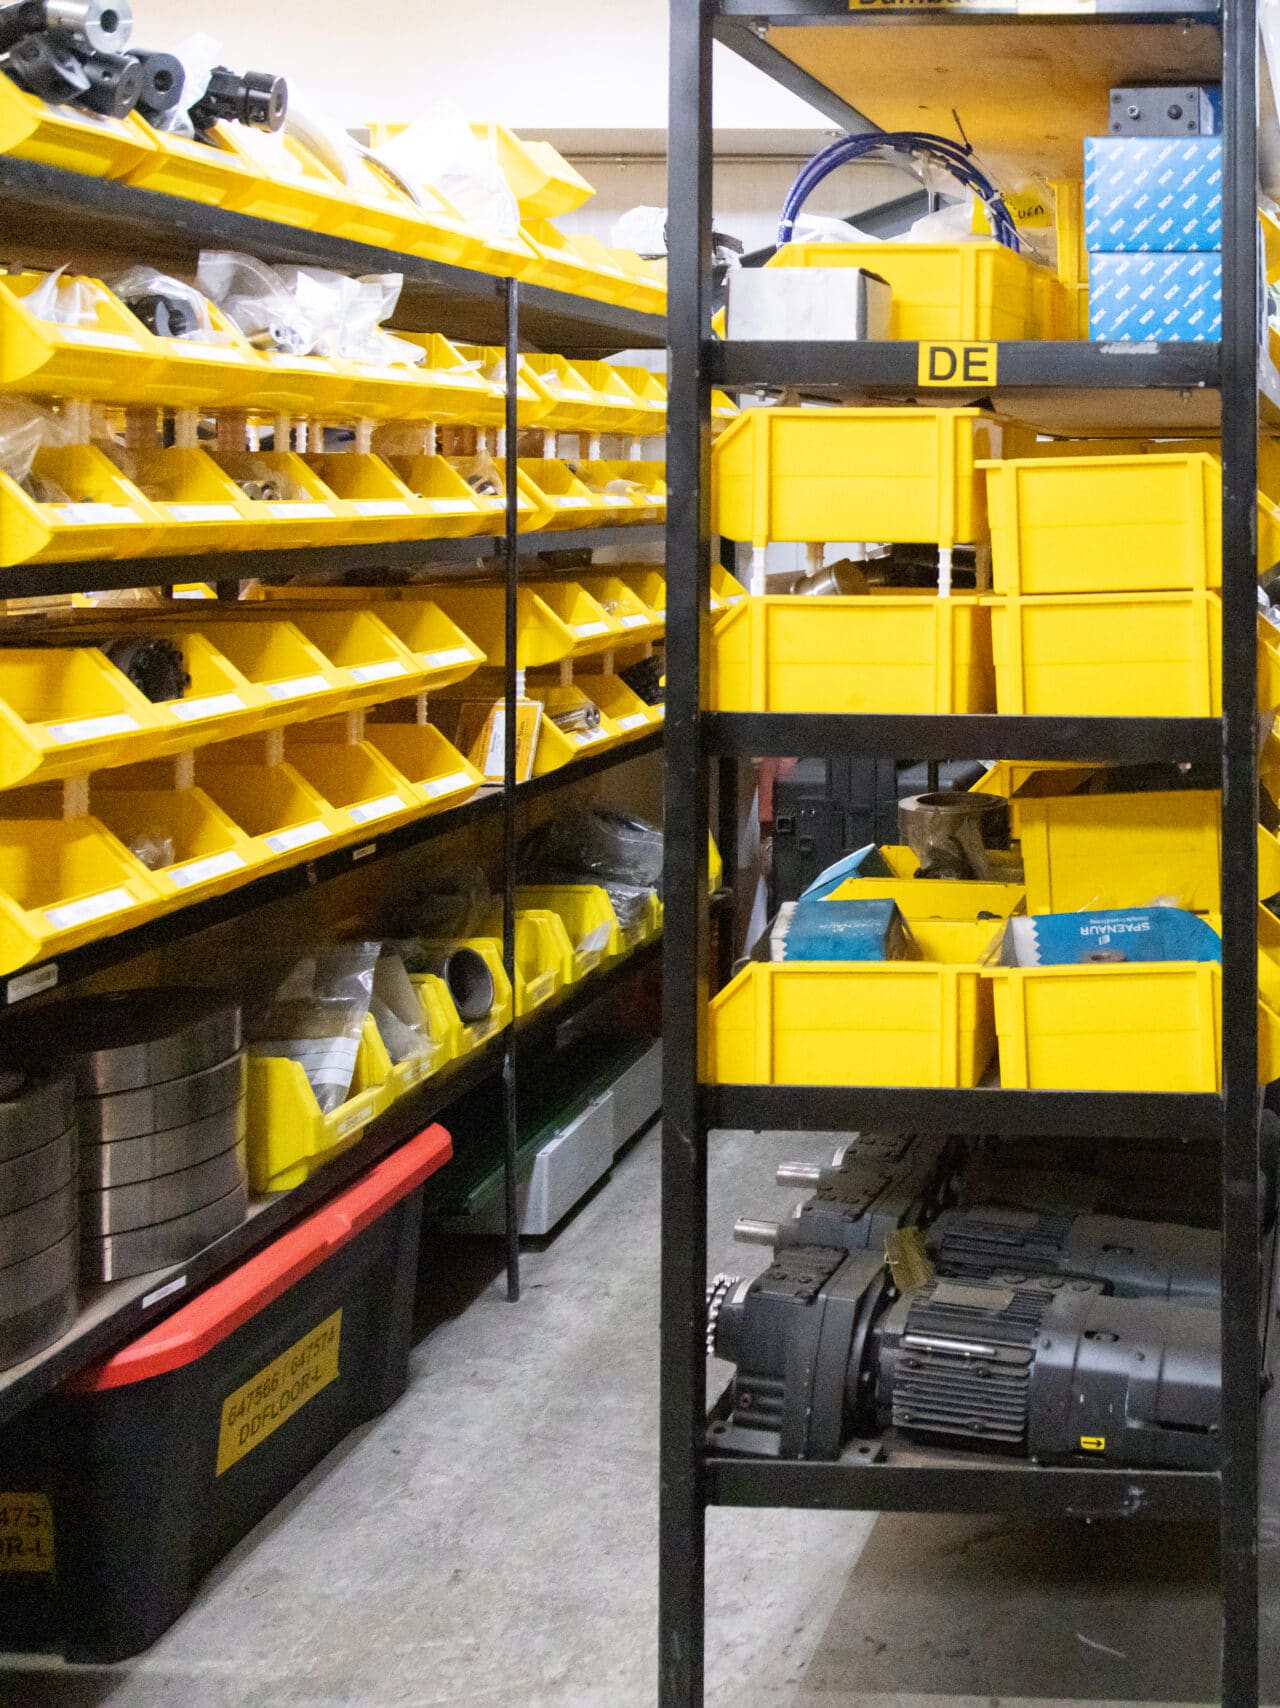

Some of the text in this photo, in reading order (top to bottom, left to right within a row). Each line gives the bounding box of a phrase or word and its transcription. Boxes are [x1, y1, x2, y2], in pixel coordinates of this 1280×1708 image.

[928, 346, 989, 382] DE
[1080, 922, 1150, 936] SPAENAUR
[239, 1365, 322, 1446] DDFLOOR-L
